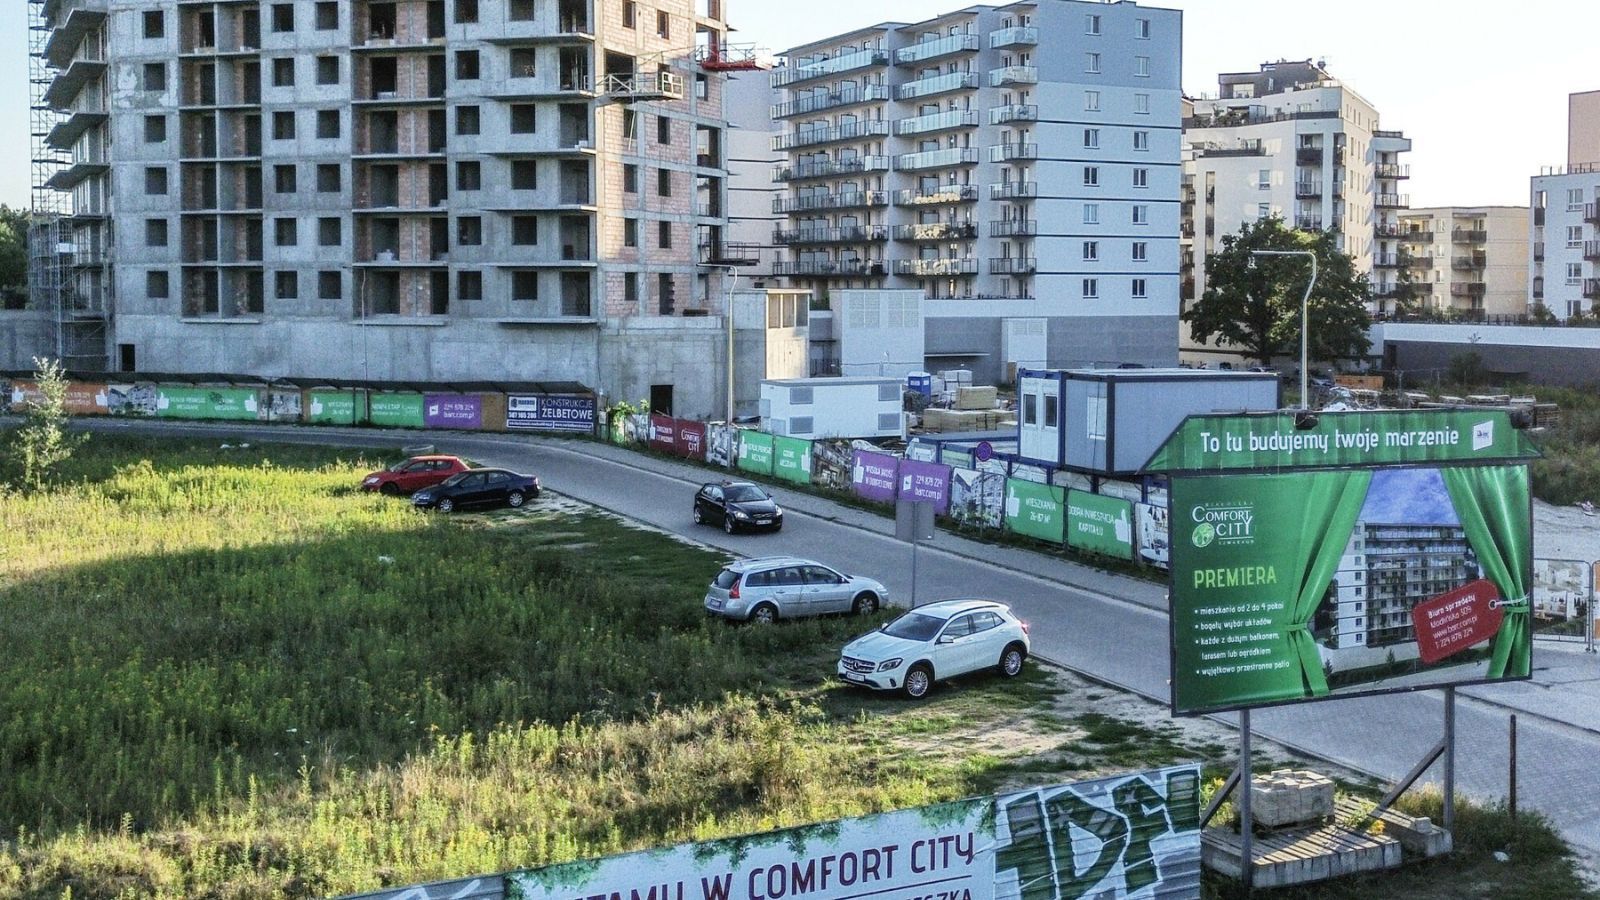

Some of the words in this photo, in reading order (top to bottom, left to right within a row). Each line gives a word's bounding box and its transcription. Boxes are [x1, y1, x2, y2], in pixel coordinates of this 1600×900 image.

[541, 399, 592, 408] KONSTRUKCJE
[542, 406, 592, 420] ŻELBETOWE
[1200, 432, 1220, 452] To
[1226, 432, 1242, 452] tu
[1250, 431, 1329, 454] budujemy
[1335, 428, 1378, 452] twoje
[1386, 426, 1459, 447] marzenie
[1026, 498, 1056, 512] MIESZKANIA
[1068, 505, 1084, 517] DOBRA
[1192, 506, 1251, 522] COMFORT
[1216, 516, 1253, 536] CITY
[1194, 566, 1277, 589] PREMIERA
[1200, 604, 1235, 615] mieszkania
[1237, 603, 1245, 612] od
[1246, 603, 1250, 611] 2
[1252, 602, 1260, 611] do
[1428, 607, 1444, 619] Biuro
[1445, 594, 1476, 612] sprzedaży
[1200, 622, 1222, 631] bogaty
[1224, 620, 1243, 629] wybór
[1200, 636, 1219, 645] każde
[1226, 634, 1248, 643] dużym
[1202, 652, 1226, 660] tarasem
[1237, 663, 1273, 673] przestronne
[1274, 660, 1290, 670] patio
[748, 845, 898, 900] COMFORT
[911, 832, 974, 874] CITY
